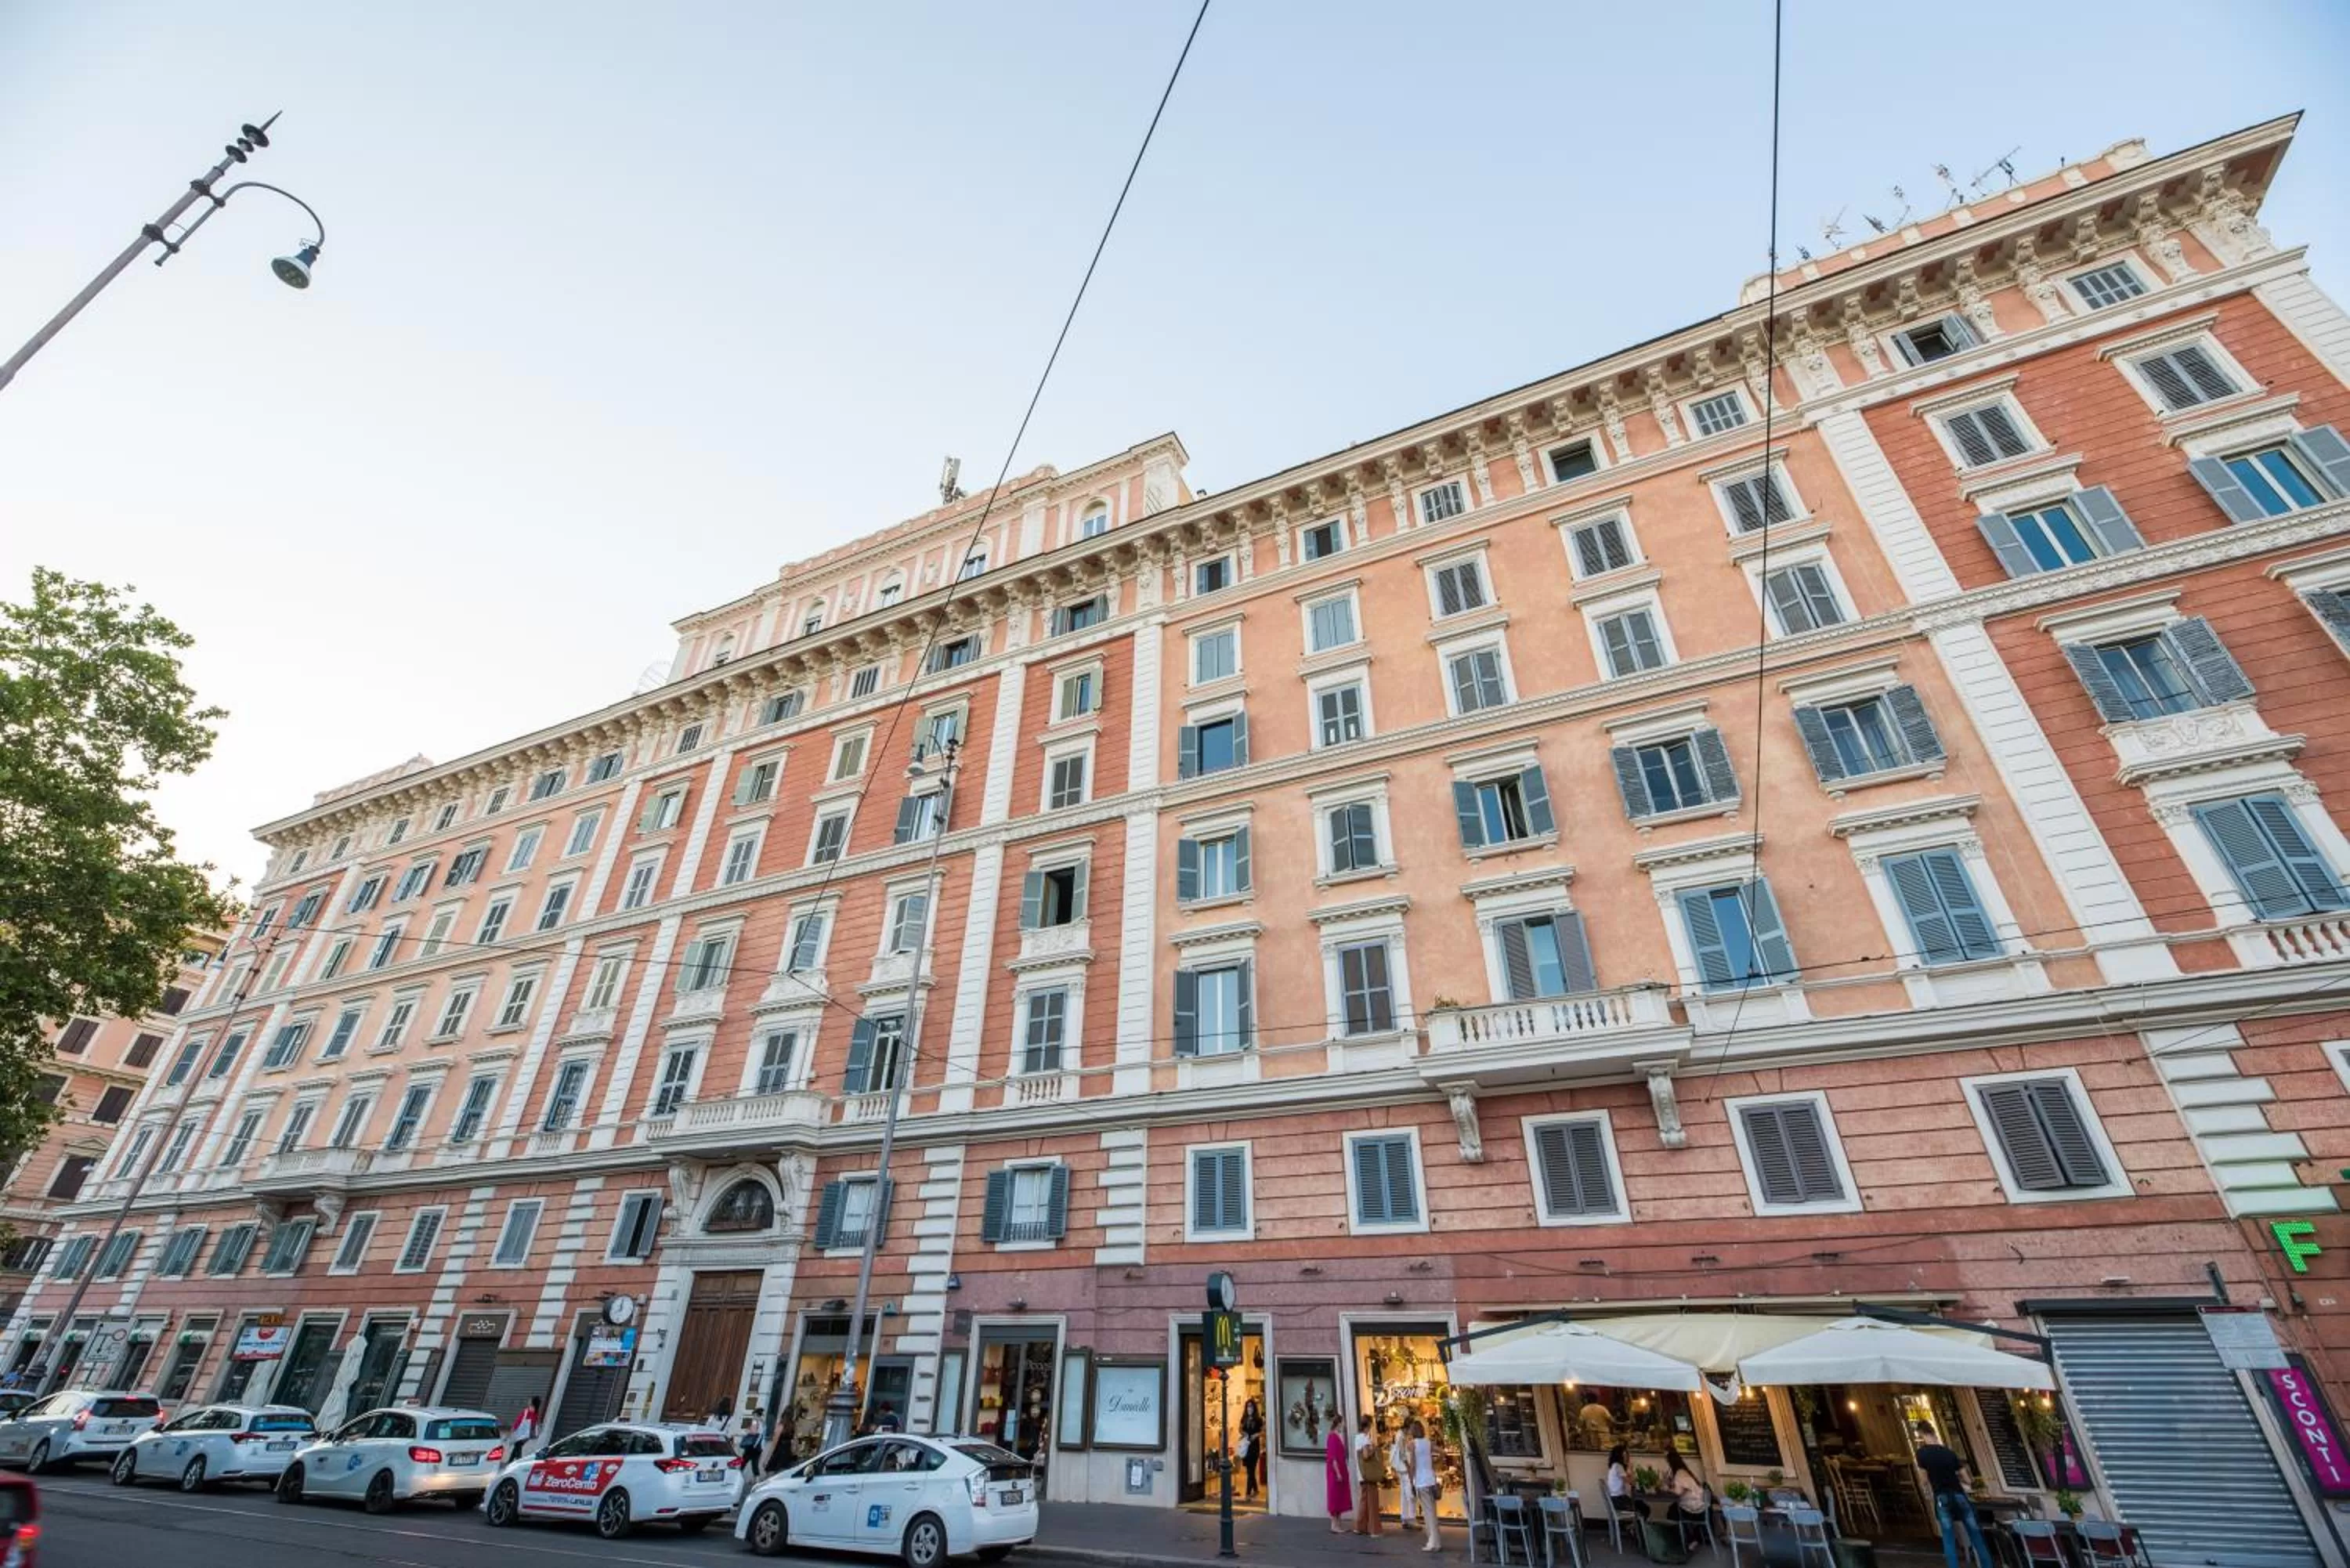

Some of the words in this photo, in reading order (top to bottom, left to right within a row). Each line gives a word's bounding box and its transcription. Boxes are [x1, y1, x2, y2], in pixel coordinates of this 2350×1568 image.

[2271, 1222, 2322, 1272] F
[2281, 1374, 2341, 1482] SCONTI
[544, 1476, 598, 1490] ZeroCento
